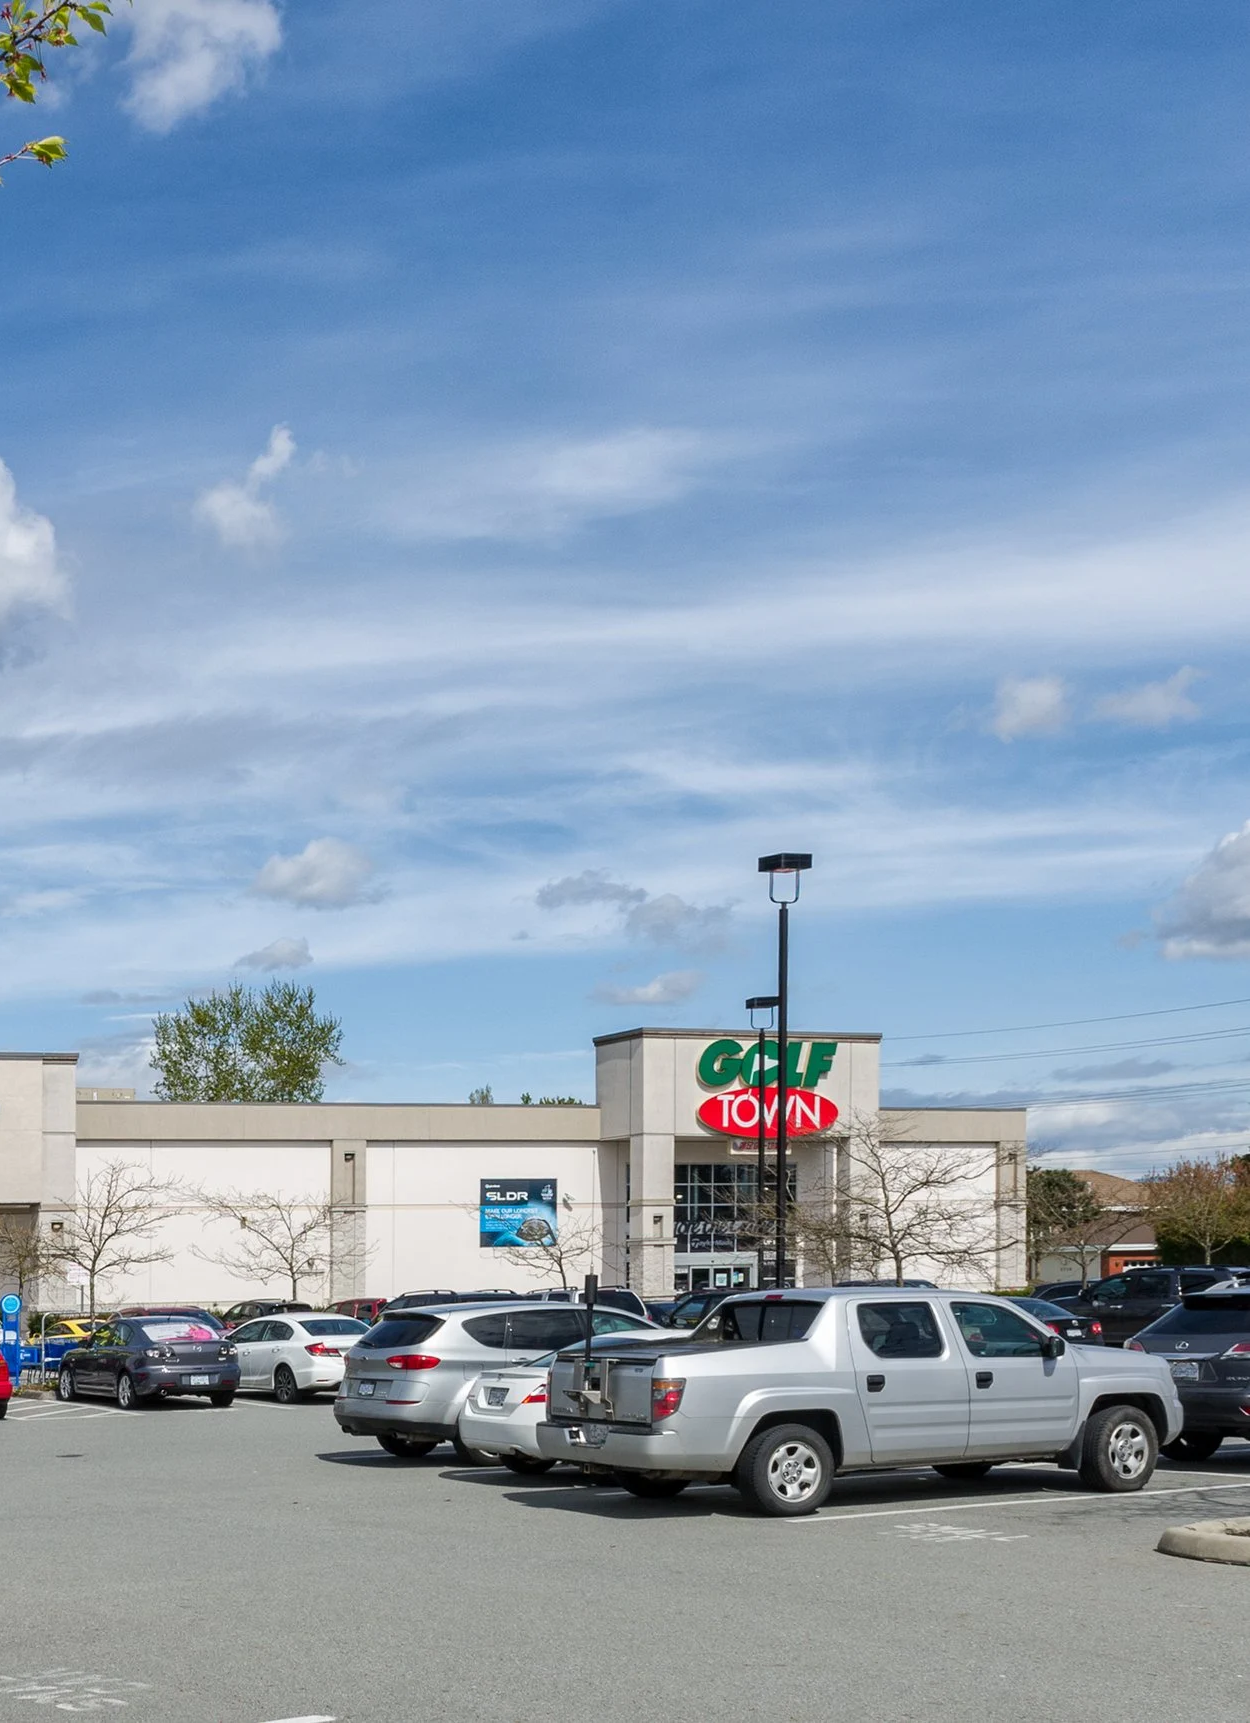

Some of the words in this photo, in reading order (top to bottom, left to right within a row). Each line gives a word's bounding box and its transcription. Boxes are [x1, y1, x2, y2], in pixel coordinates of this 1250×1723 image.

[698, 1039, 838, 1088] GOLF
[717, 1094, 822, 1129] TOWN
[485, 1191, 528, 1201] SLDR
